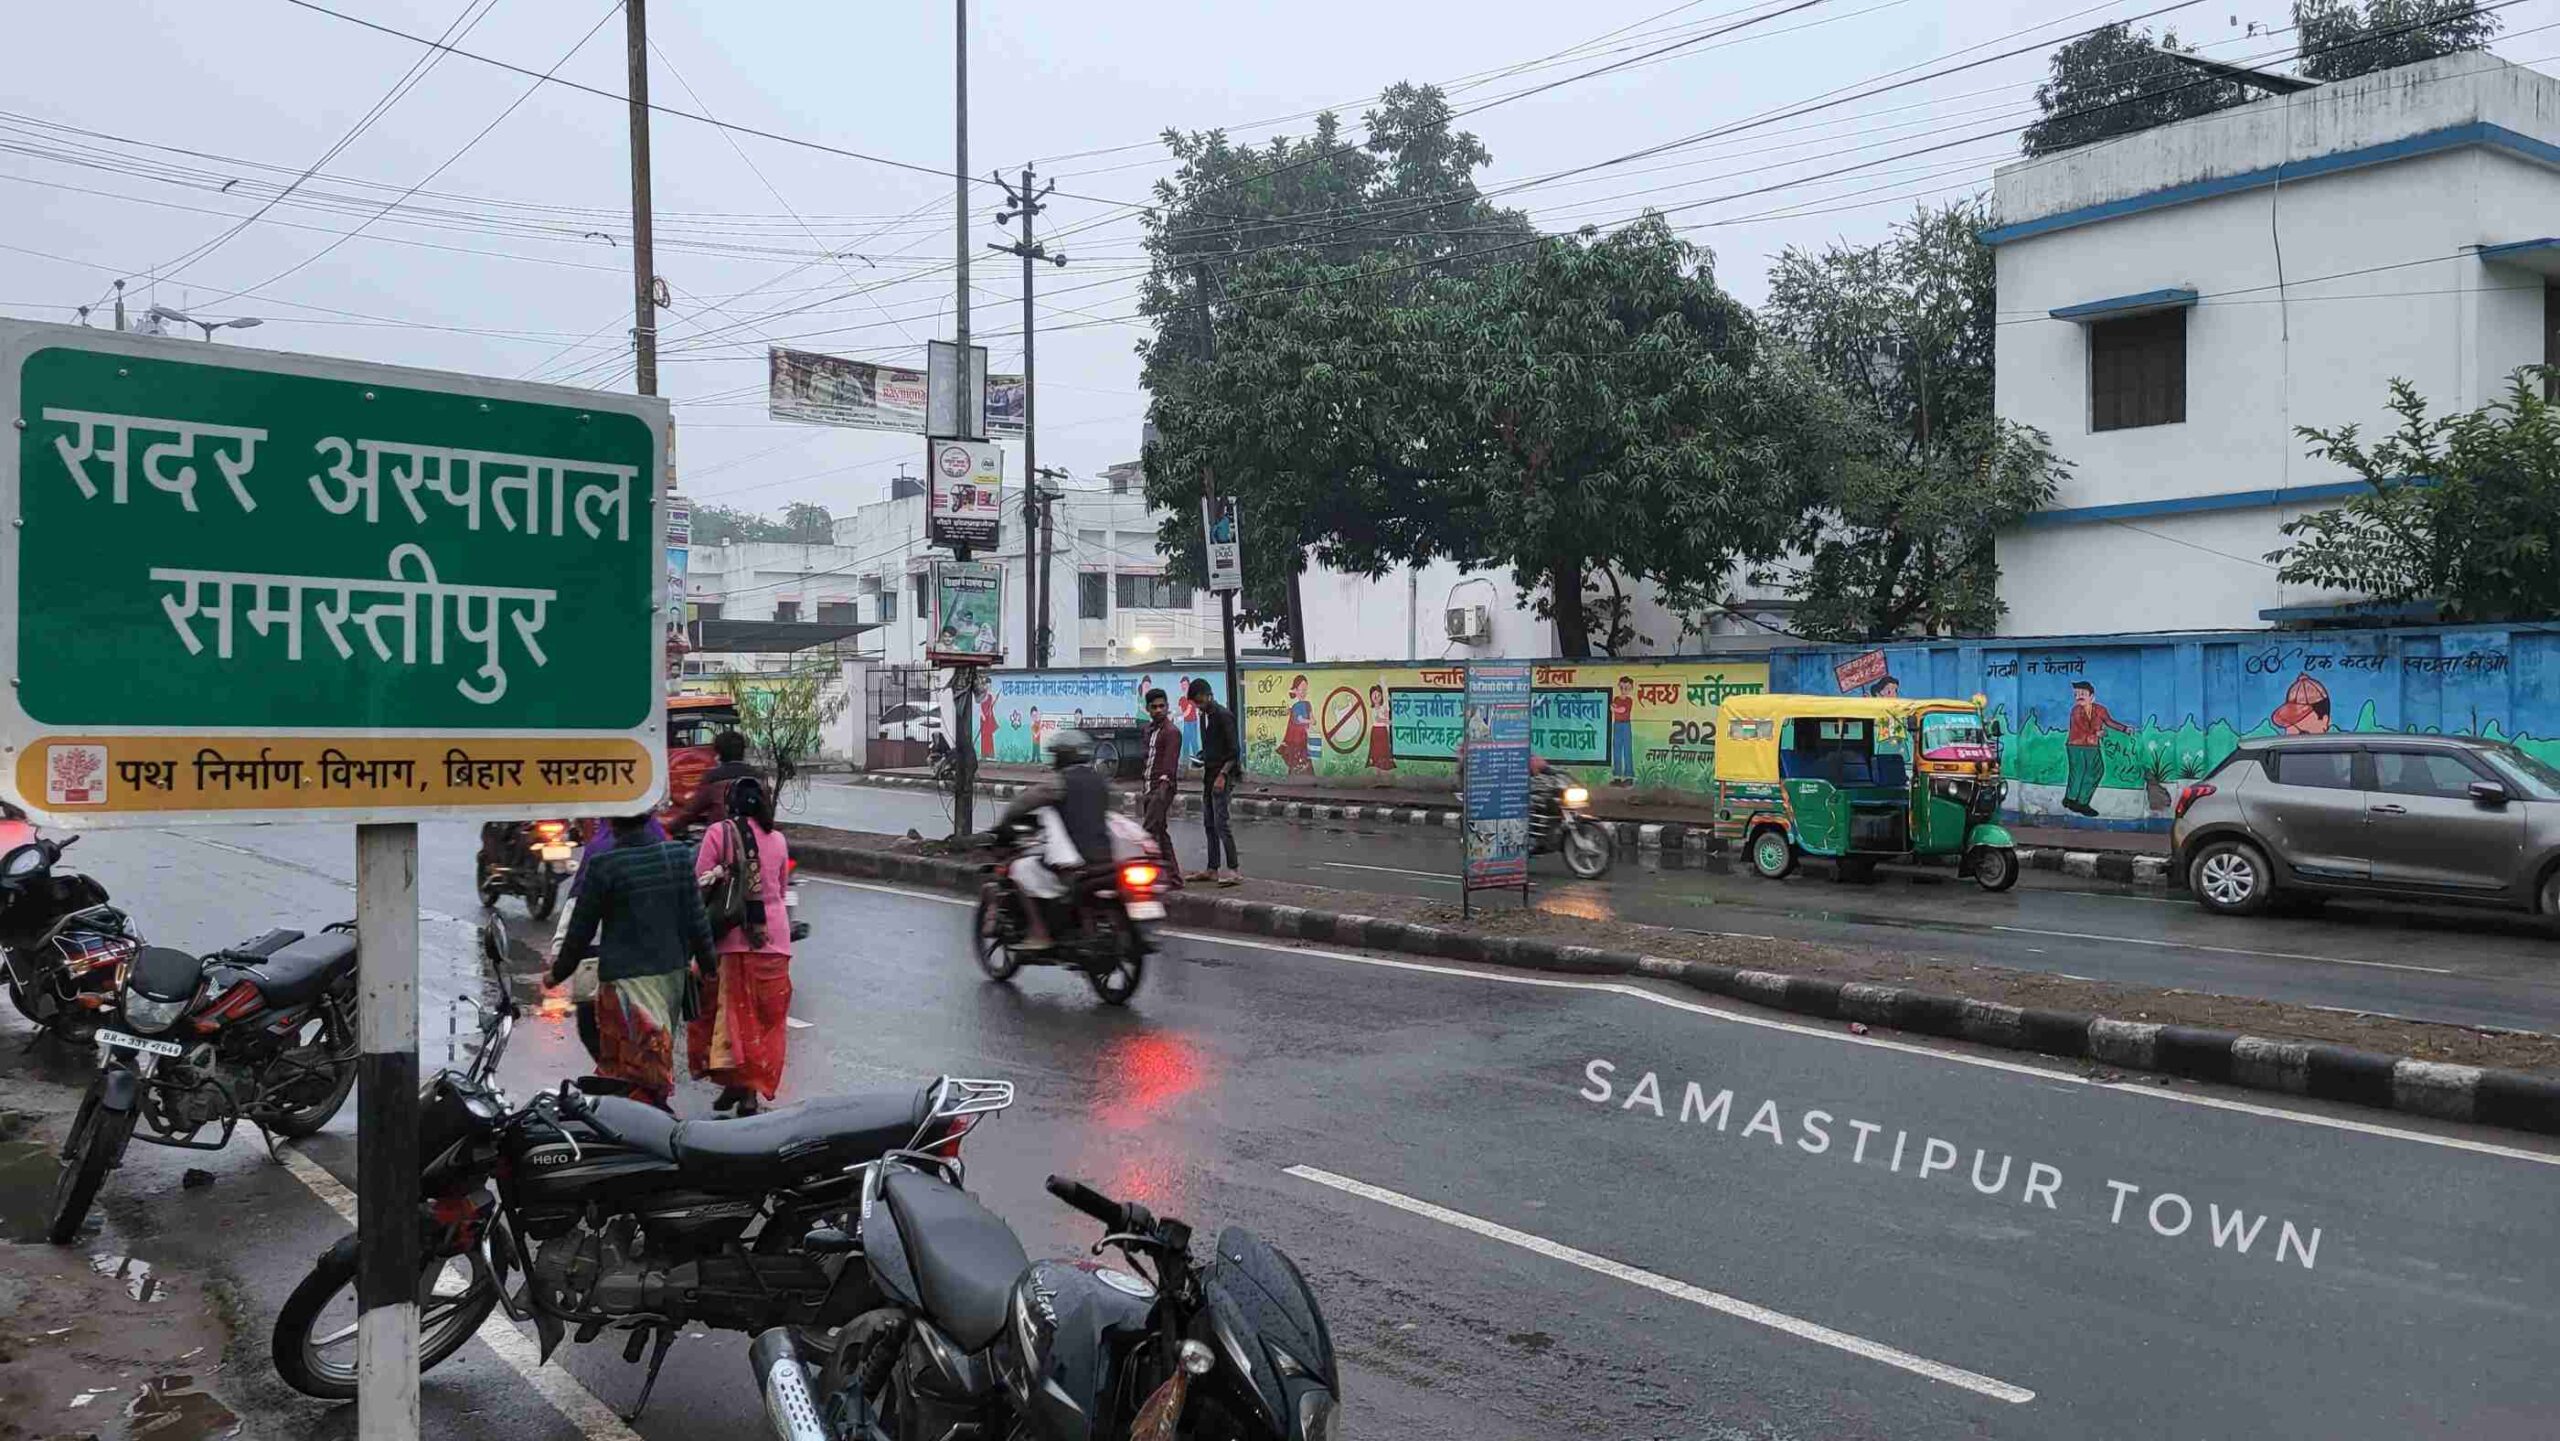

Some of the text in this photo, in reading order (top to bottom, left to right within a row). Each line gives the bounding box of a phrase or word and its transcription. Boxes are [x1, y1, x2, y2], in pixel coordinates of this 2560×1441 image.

[42, 407, 639, 541] सदर अस्पताल
[150, 543, 557, 704] समस्तीपुर
[1987, 659, 2019, 678] गंदगी
[2027, 661, 2040, 674] न
[2304, 654, 2335, 672] एक
[2338, 654, 2388, 673] कदम
[1413, 694, 1457, 717] जमीन
[1637, 683, 1681, 708] स्वच्छ
[1669, 720, 1716, 745] 202
[116, 747, 637, 792] पथ निर्माण विभाग, बिहार सरकार
